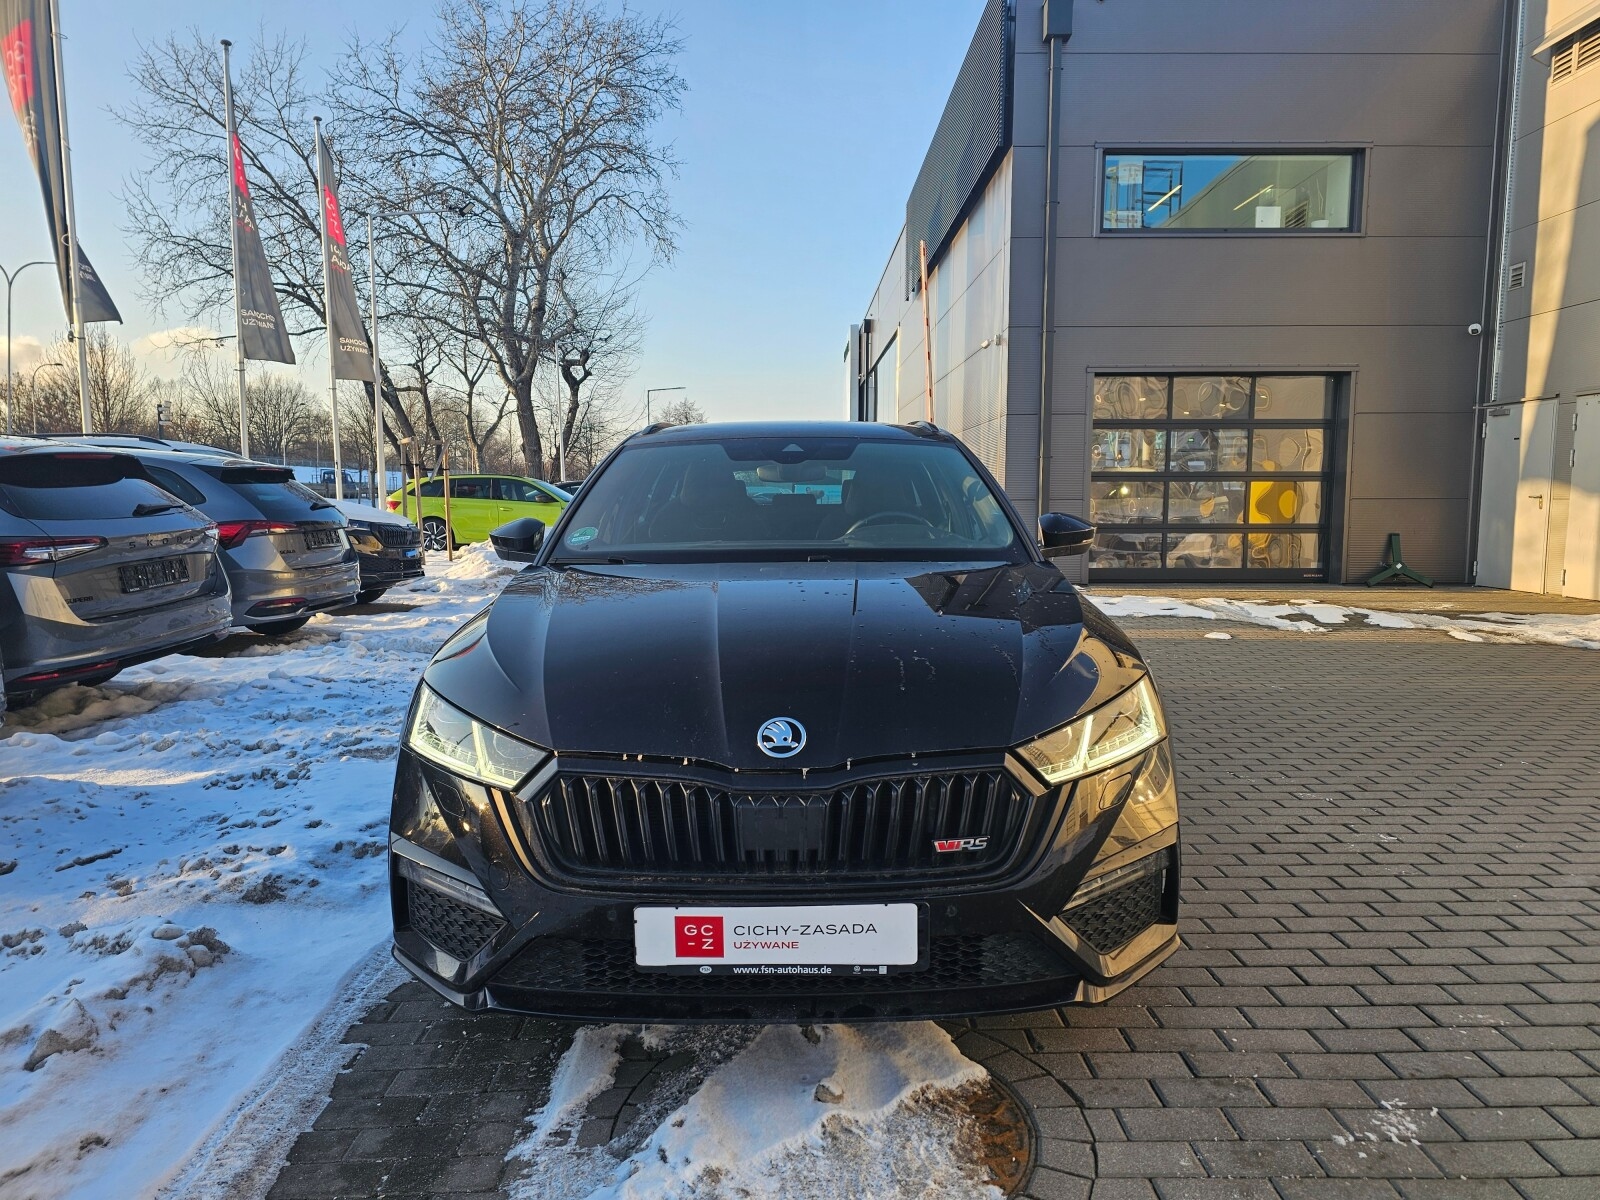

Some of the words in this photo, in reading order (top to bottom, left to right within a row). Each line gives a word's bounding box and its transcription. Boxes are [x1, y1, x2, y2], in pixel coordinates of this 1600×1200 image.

[65, 595, 94, 604] SUPERB
[733, 923, 878, 936] CICHY-ZASADA
[733, 939, 800, 950] UŻYWANE
[733, 964, 832, 974] www.fsn-autohaus.de
